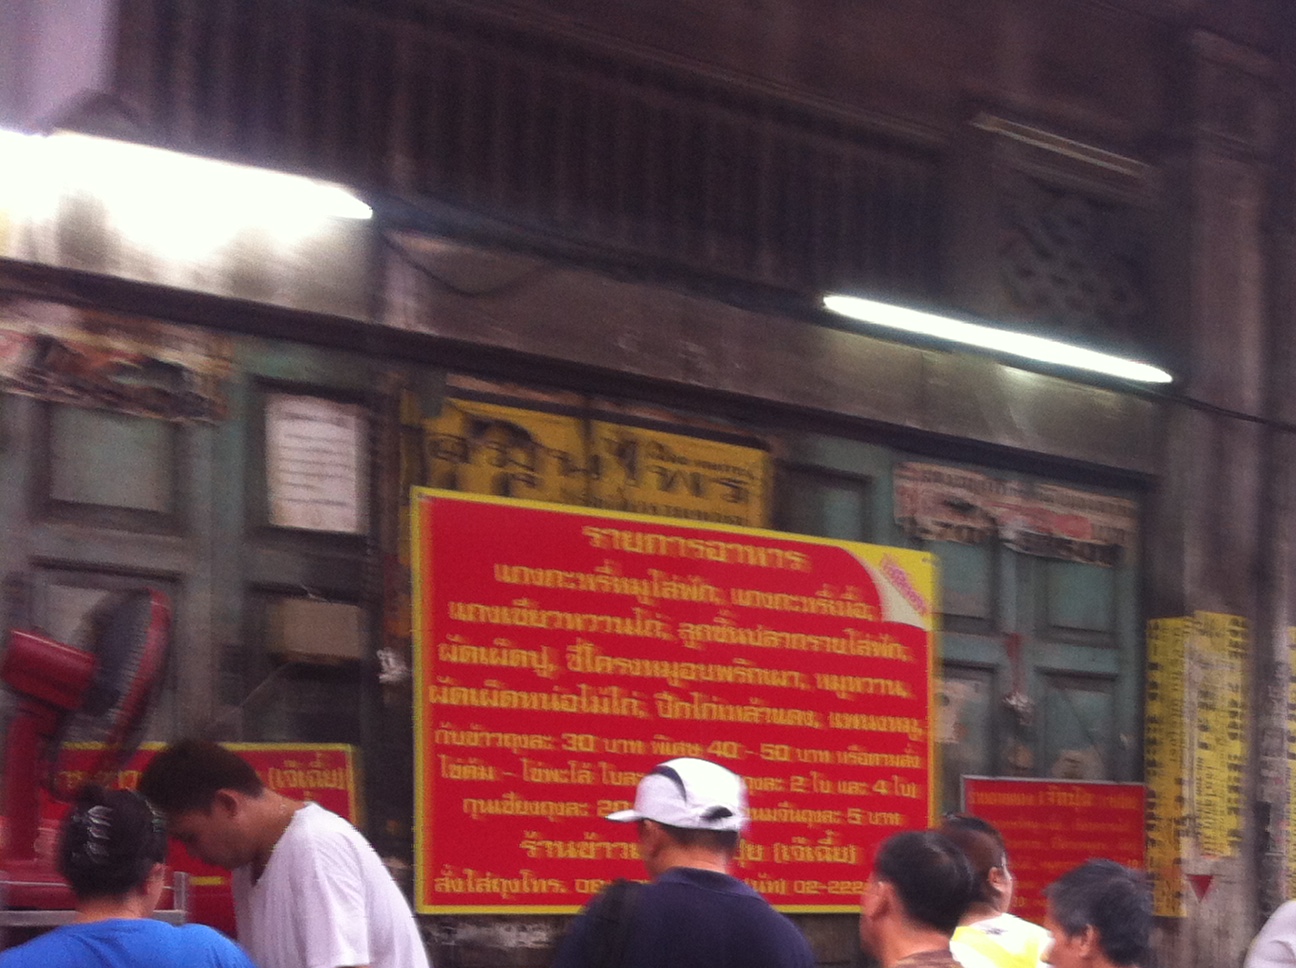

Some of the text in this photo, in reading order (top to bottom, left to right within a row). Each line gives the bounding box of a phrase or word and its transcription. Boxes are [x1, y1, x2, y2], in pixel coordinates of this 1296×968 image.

[582, 526, 811, 571] รายการอาหาร
[562, 733, 597, 752] 30
[604, 738, 644, 754] บาท
[707, 741, 742, 759] 40
[760, 743, 793, 762] 50
[797, 747, 832, 763] บาท
